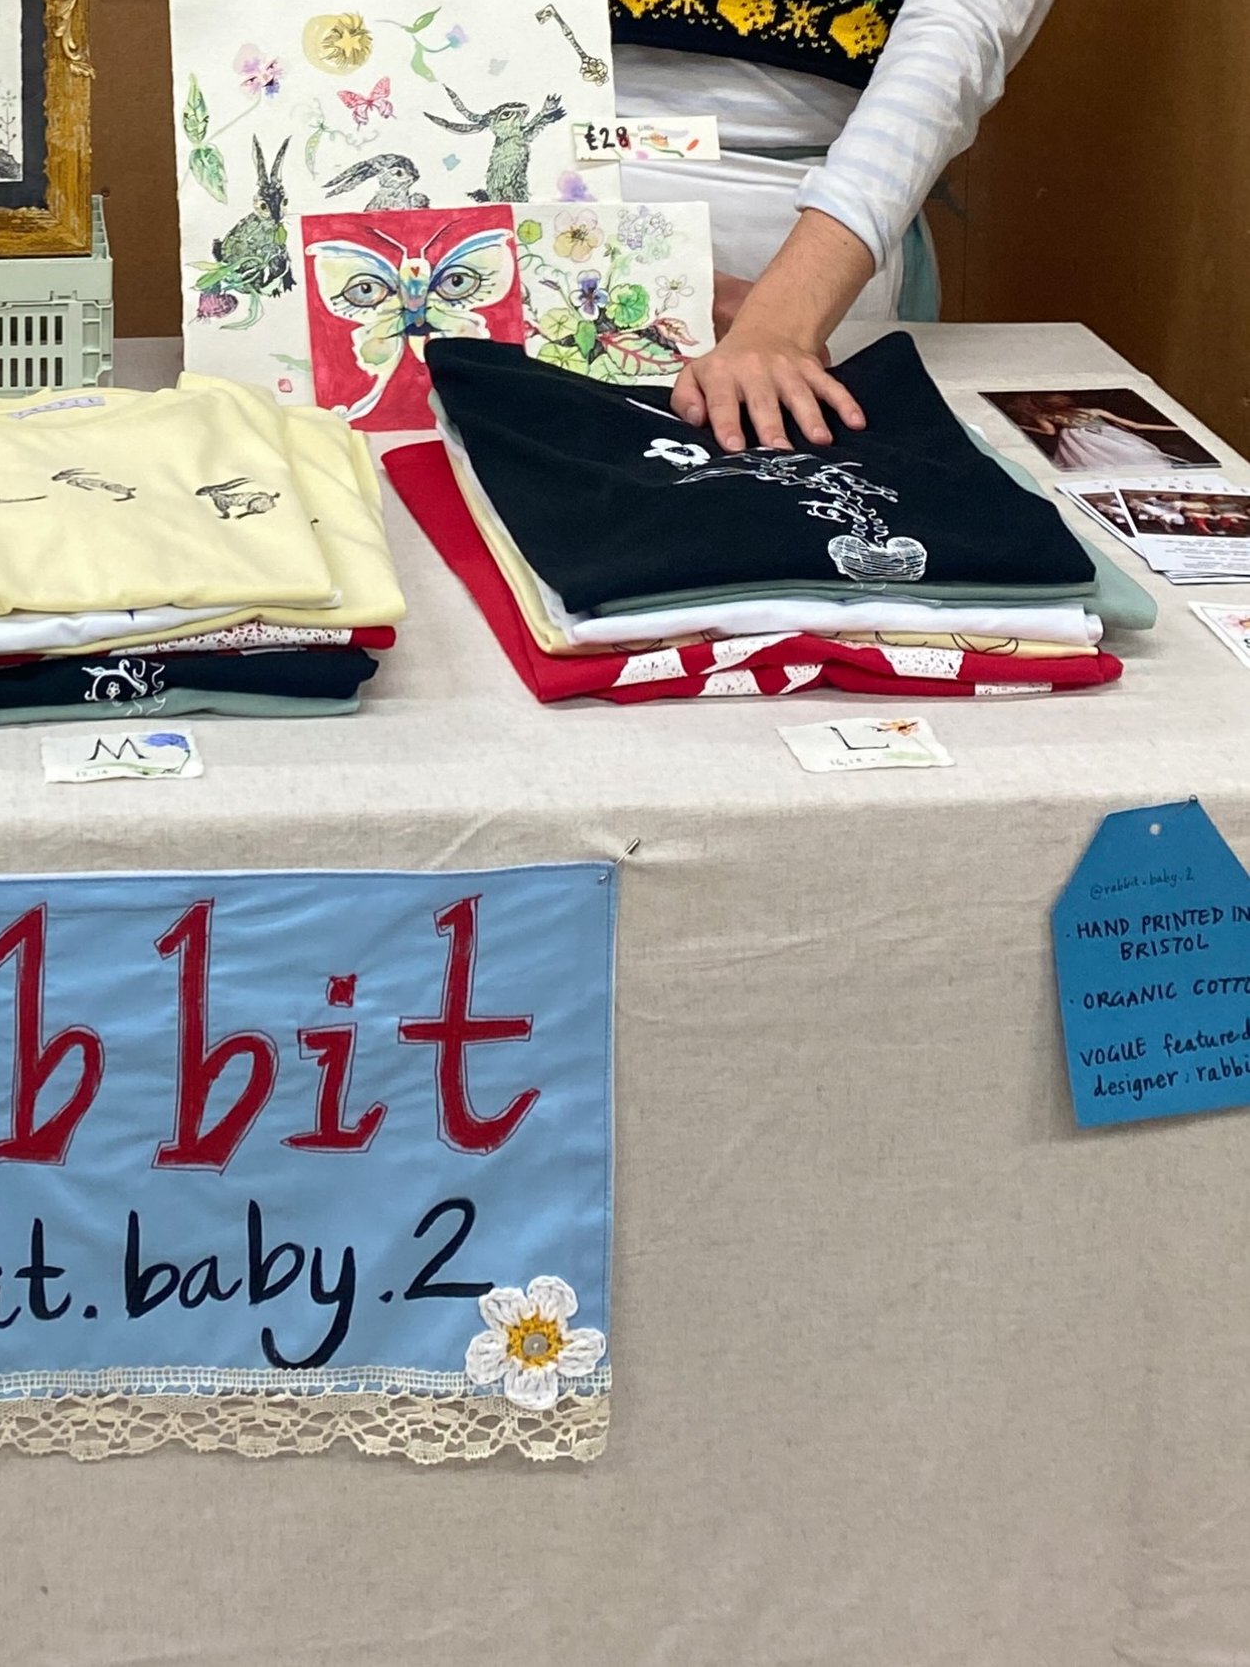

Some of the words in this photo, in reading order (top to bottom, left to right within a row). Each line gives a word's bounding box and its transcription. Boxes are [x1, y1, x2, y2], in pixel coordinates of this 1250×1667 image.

[584, 125, 630, 151] £28
[86, 738, 150, 761] M
[824, 726, 890, 750] L
[1076, 917, 1131, 940] HAND
[1141, 906, 1224, 935] PRINTED
[1232, 905, 1250, 922] IN
[1120, 933, 1210, 962] BRISTOL
[1083, 981, 1178, 1010] ORGANIC
[1079, 1036, 1147, 1067] VOGUE
[1162, 1016, 1250, 1058] featured
